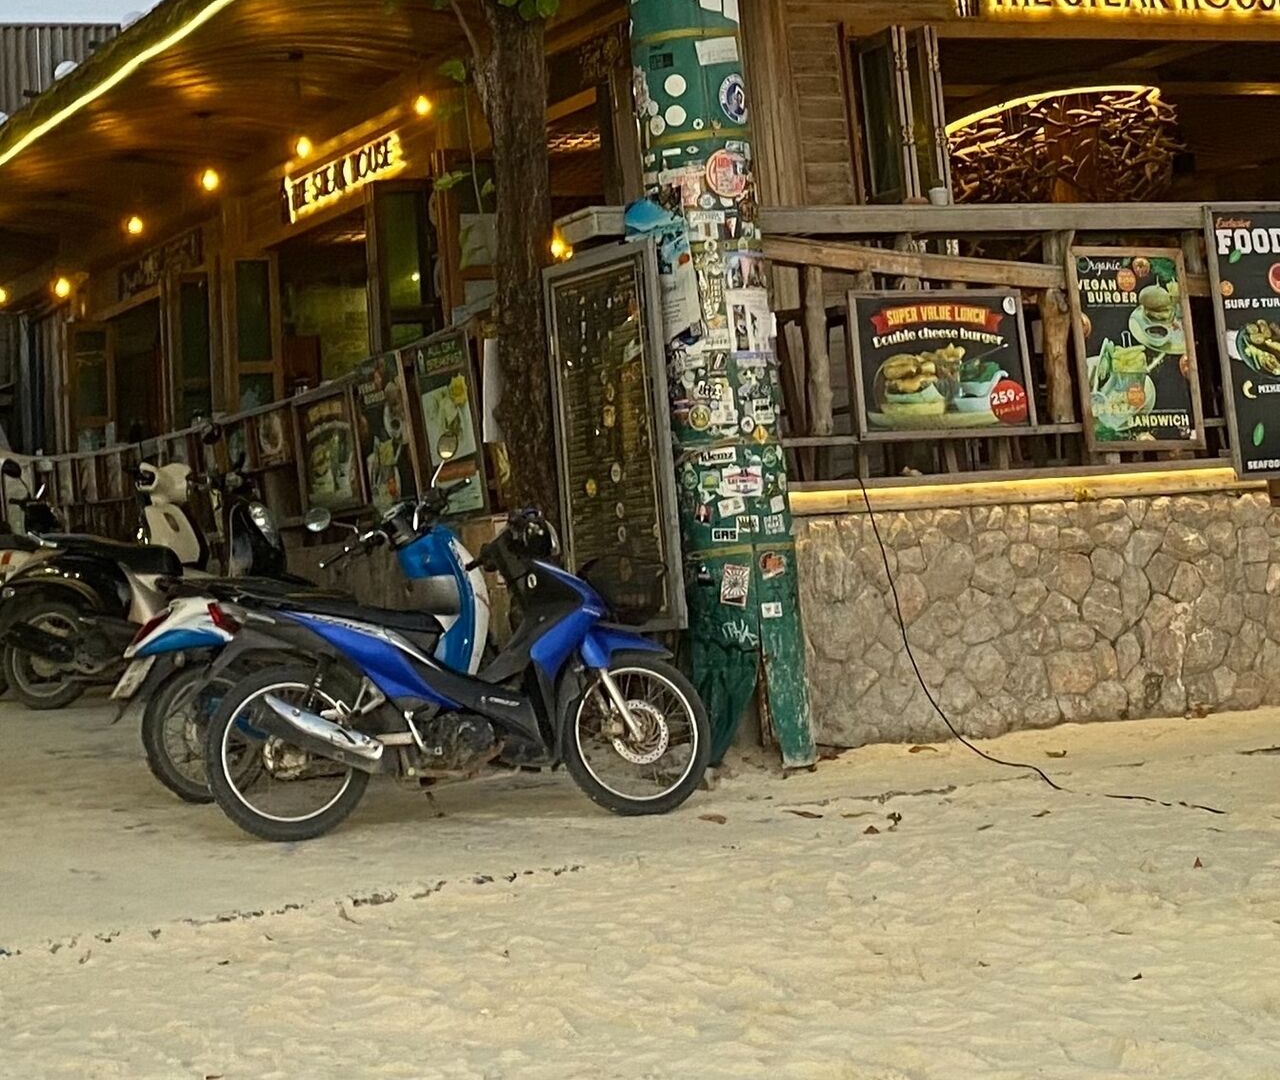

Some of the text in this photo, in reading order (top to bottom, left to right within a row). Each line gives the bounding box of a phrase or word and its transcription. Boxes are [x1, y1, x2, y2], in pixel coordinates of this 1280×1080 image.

[1078, 256, 1121, 276] Organic
[1087, 291, 1137, 303] BURGER
[1224, 299, 1250, 309] SURF
[886, 306, 987, 326] SUPER VALUE LUNCH
[872, 327, 1004, 348] Double cheese burger
[1128, 414, 1190, 427] SANDWICH
[701, 451, 734, 462] klemz
[713, 530, 737, 539] GAS
